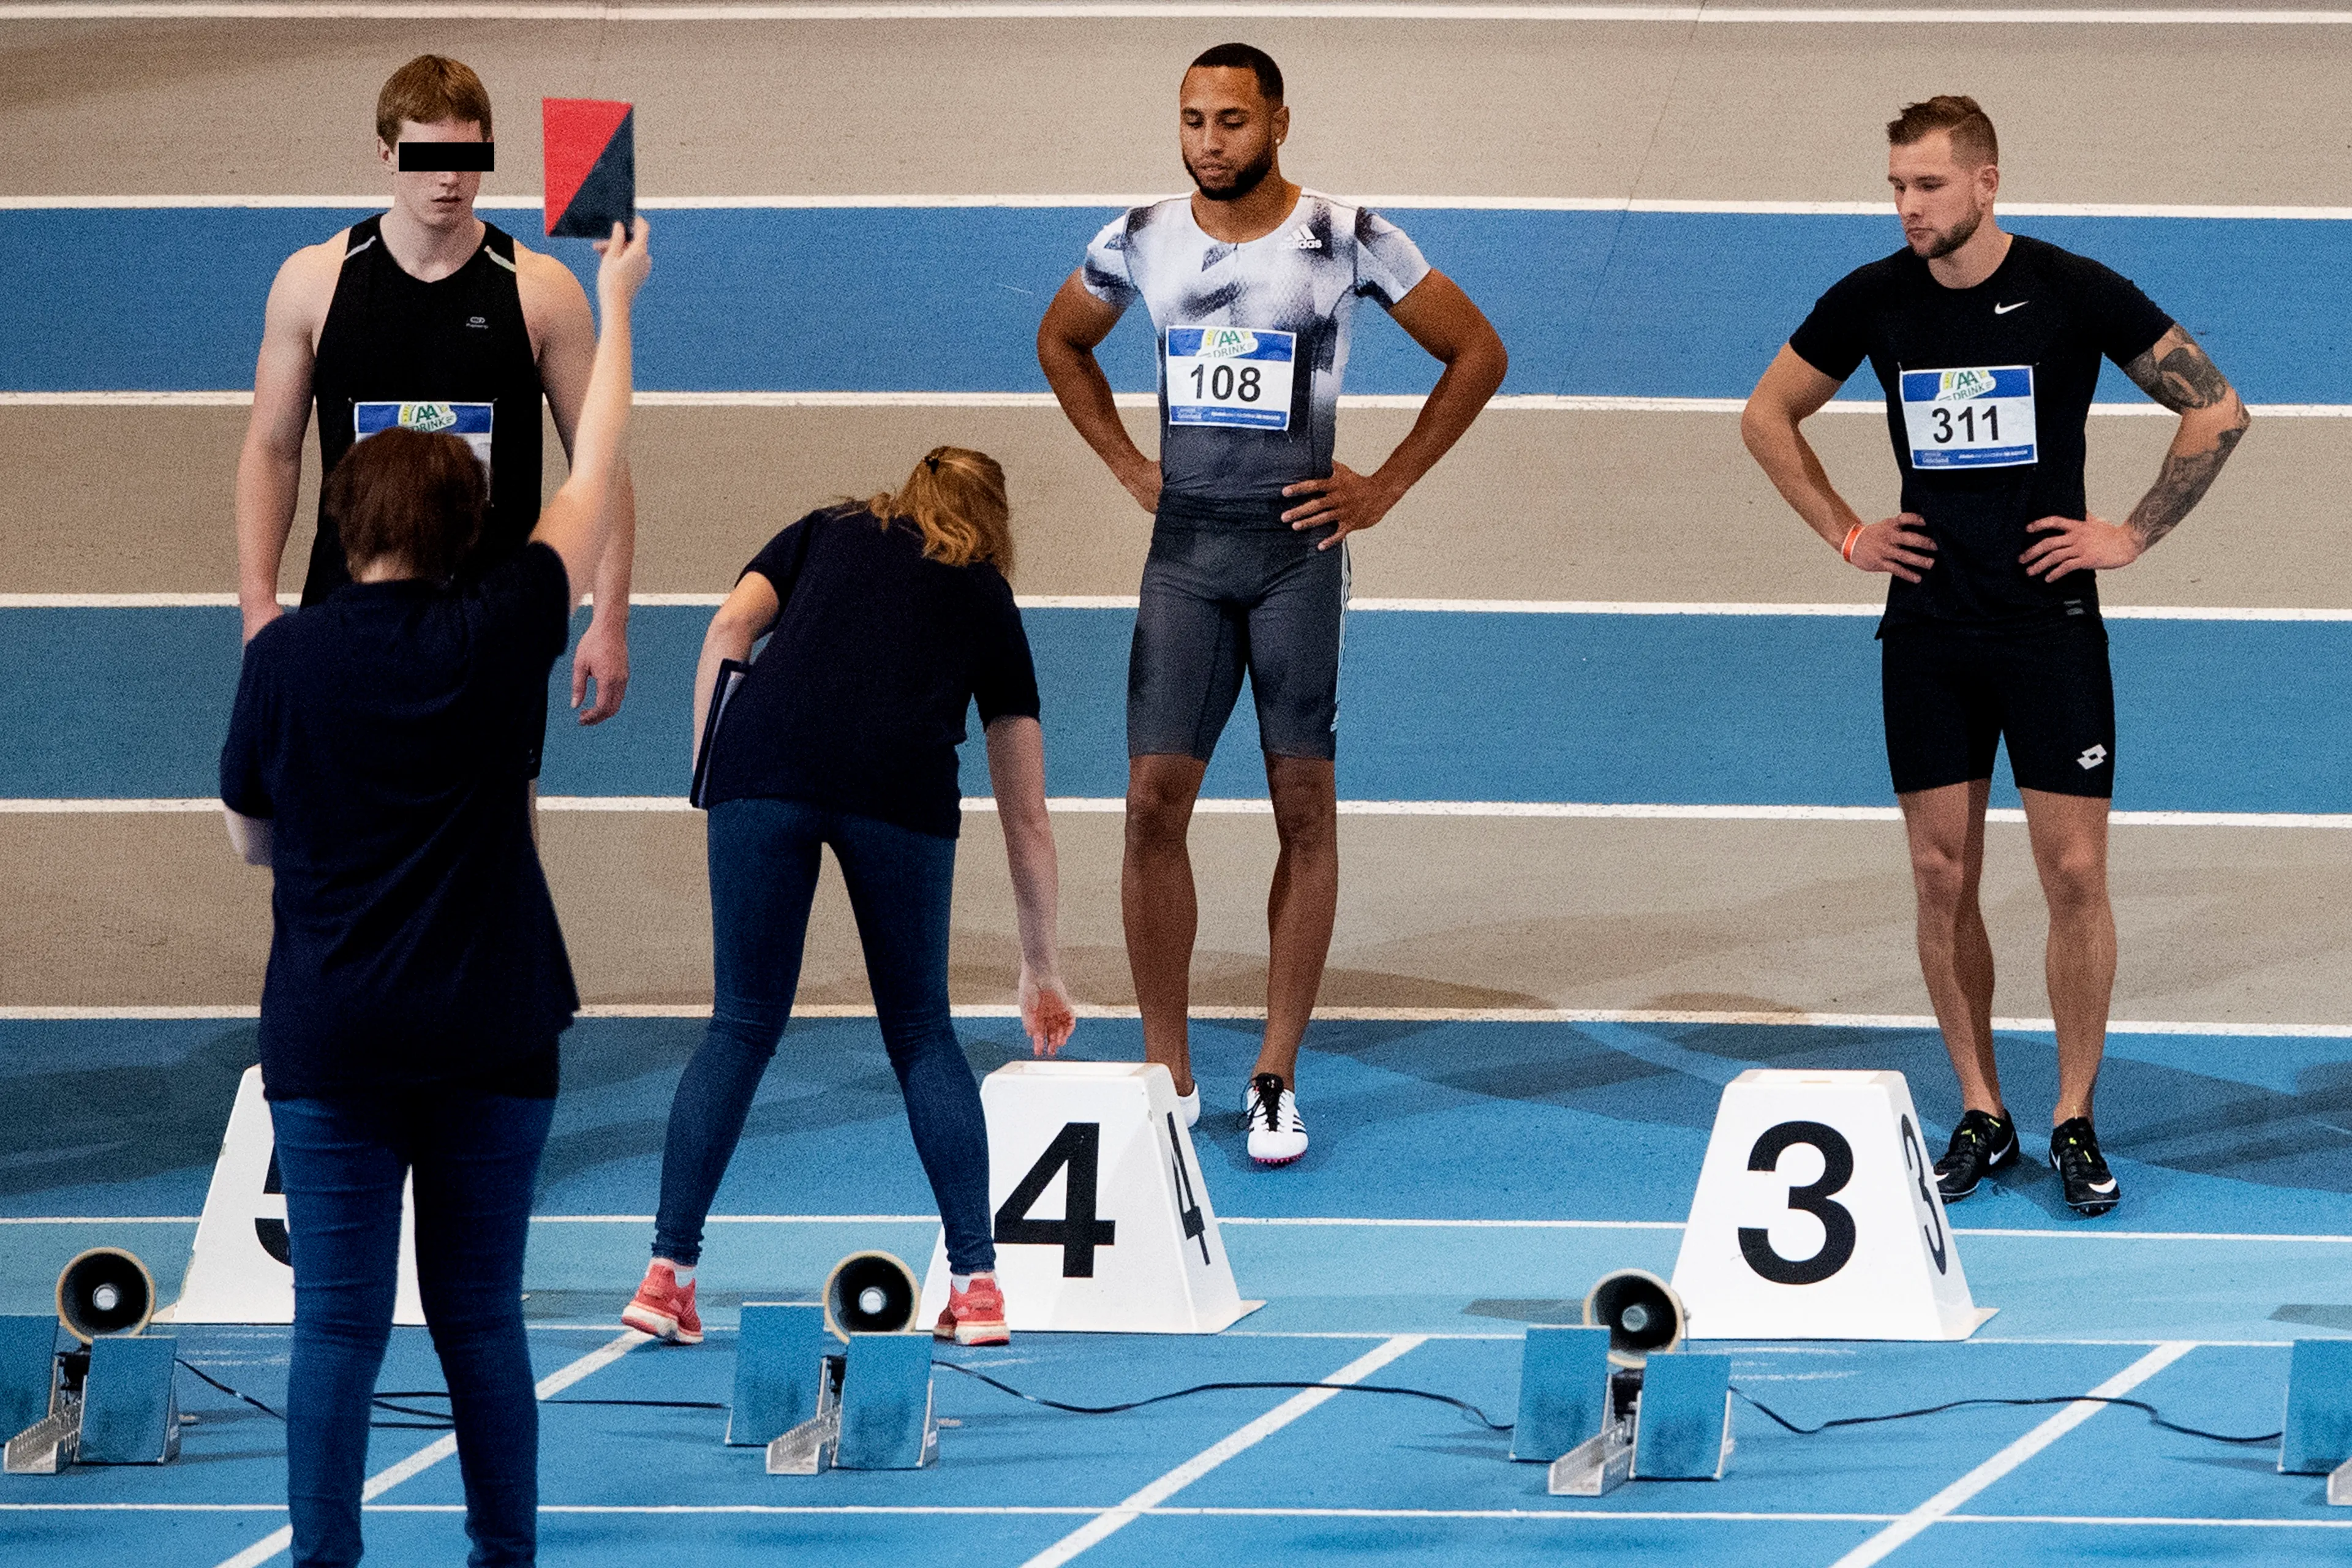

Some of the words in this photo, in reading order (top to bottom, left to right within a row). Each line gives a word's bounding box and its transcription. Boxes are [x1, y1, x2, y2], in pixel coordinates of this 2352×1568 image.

[1279, 238, 1322, 249] adidas
[1213, 345, 1247, 358] DRINK
[1218, 330, 1241, 347] AA
[1191, 363, 1261, 402] 108
[1953, 385, 1985, 400] DRINK
[1957, 370, 1978, 389] AA
[415, 404, 439, 423] AA
[1931, 405, 1999, 443] 311
[994, 1122, 1115, 1278] 4
[1166, 1111, 1210, 1265] 4
[1901, 1113, 1947, 1276] 3
[1737, 1120, 1856, 1285] 3
